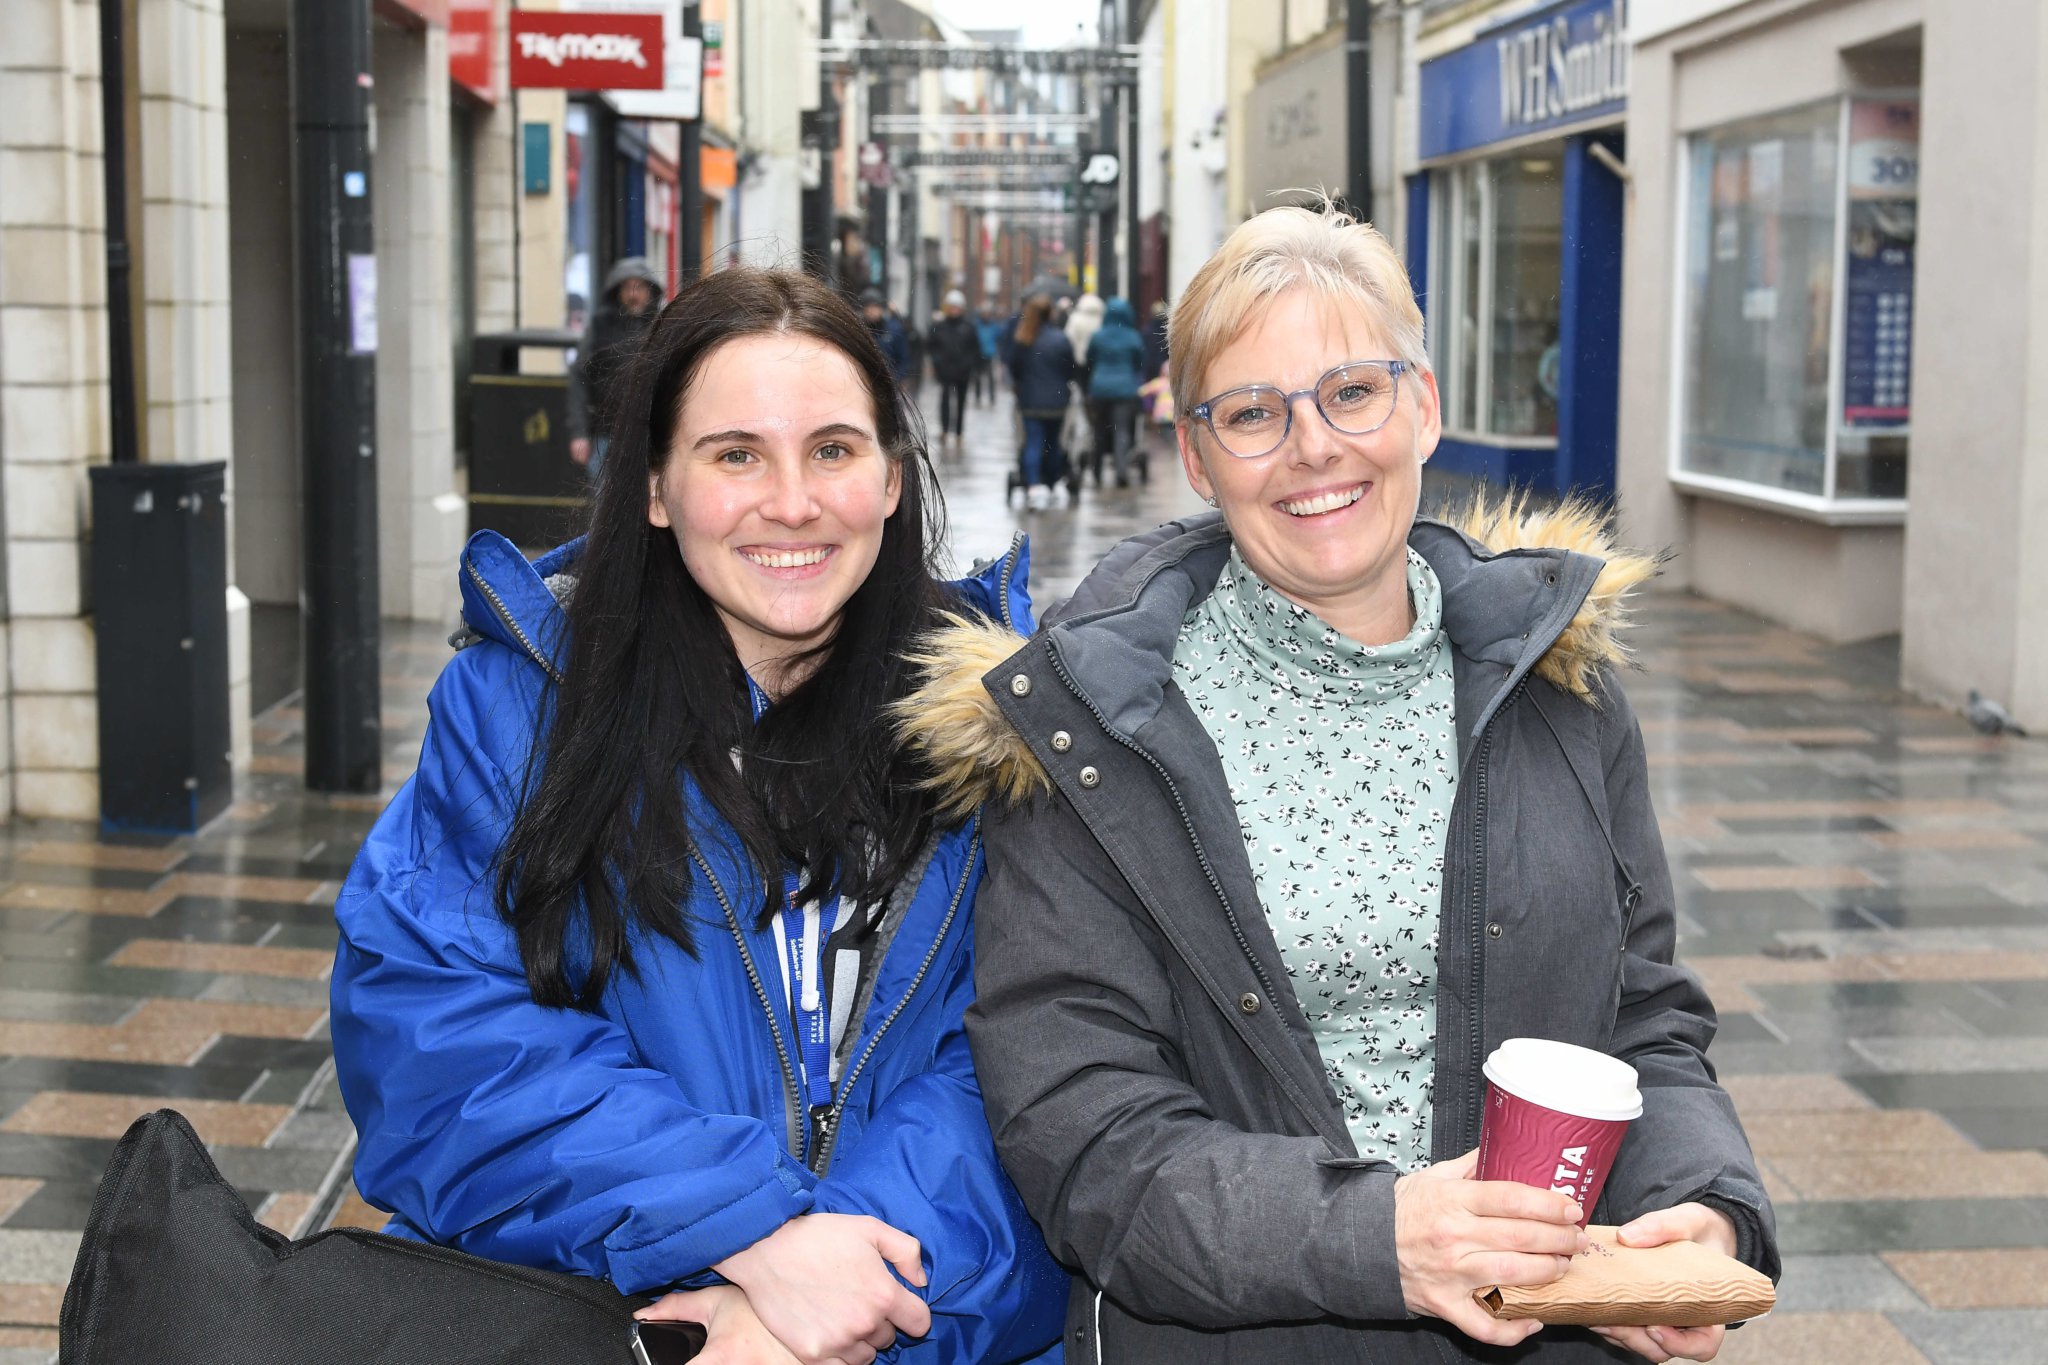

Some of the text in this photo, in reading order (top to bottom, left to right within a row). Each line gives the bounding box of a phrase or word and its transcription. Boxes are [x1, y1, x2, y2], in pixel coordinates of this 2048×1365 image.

[1497, 0, 1629, 127] WHSmith
[1551, 1146, 1587, 1197] STA
[1577, 1168, 1594, 1208] OFFEE
